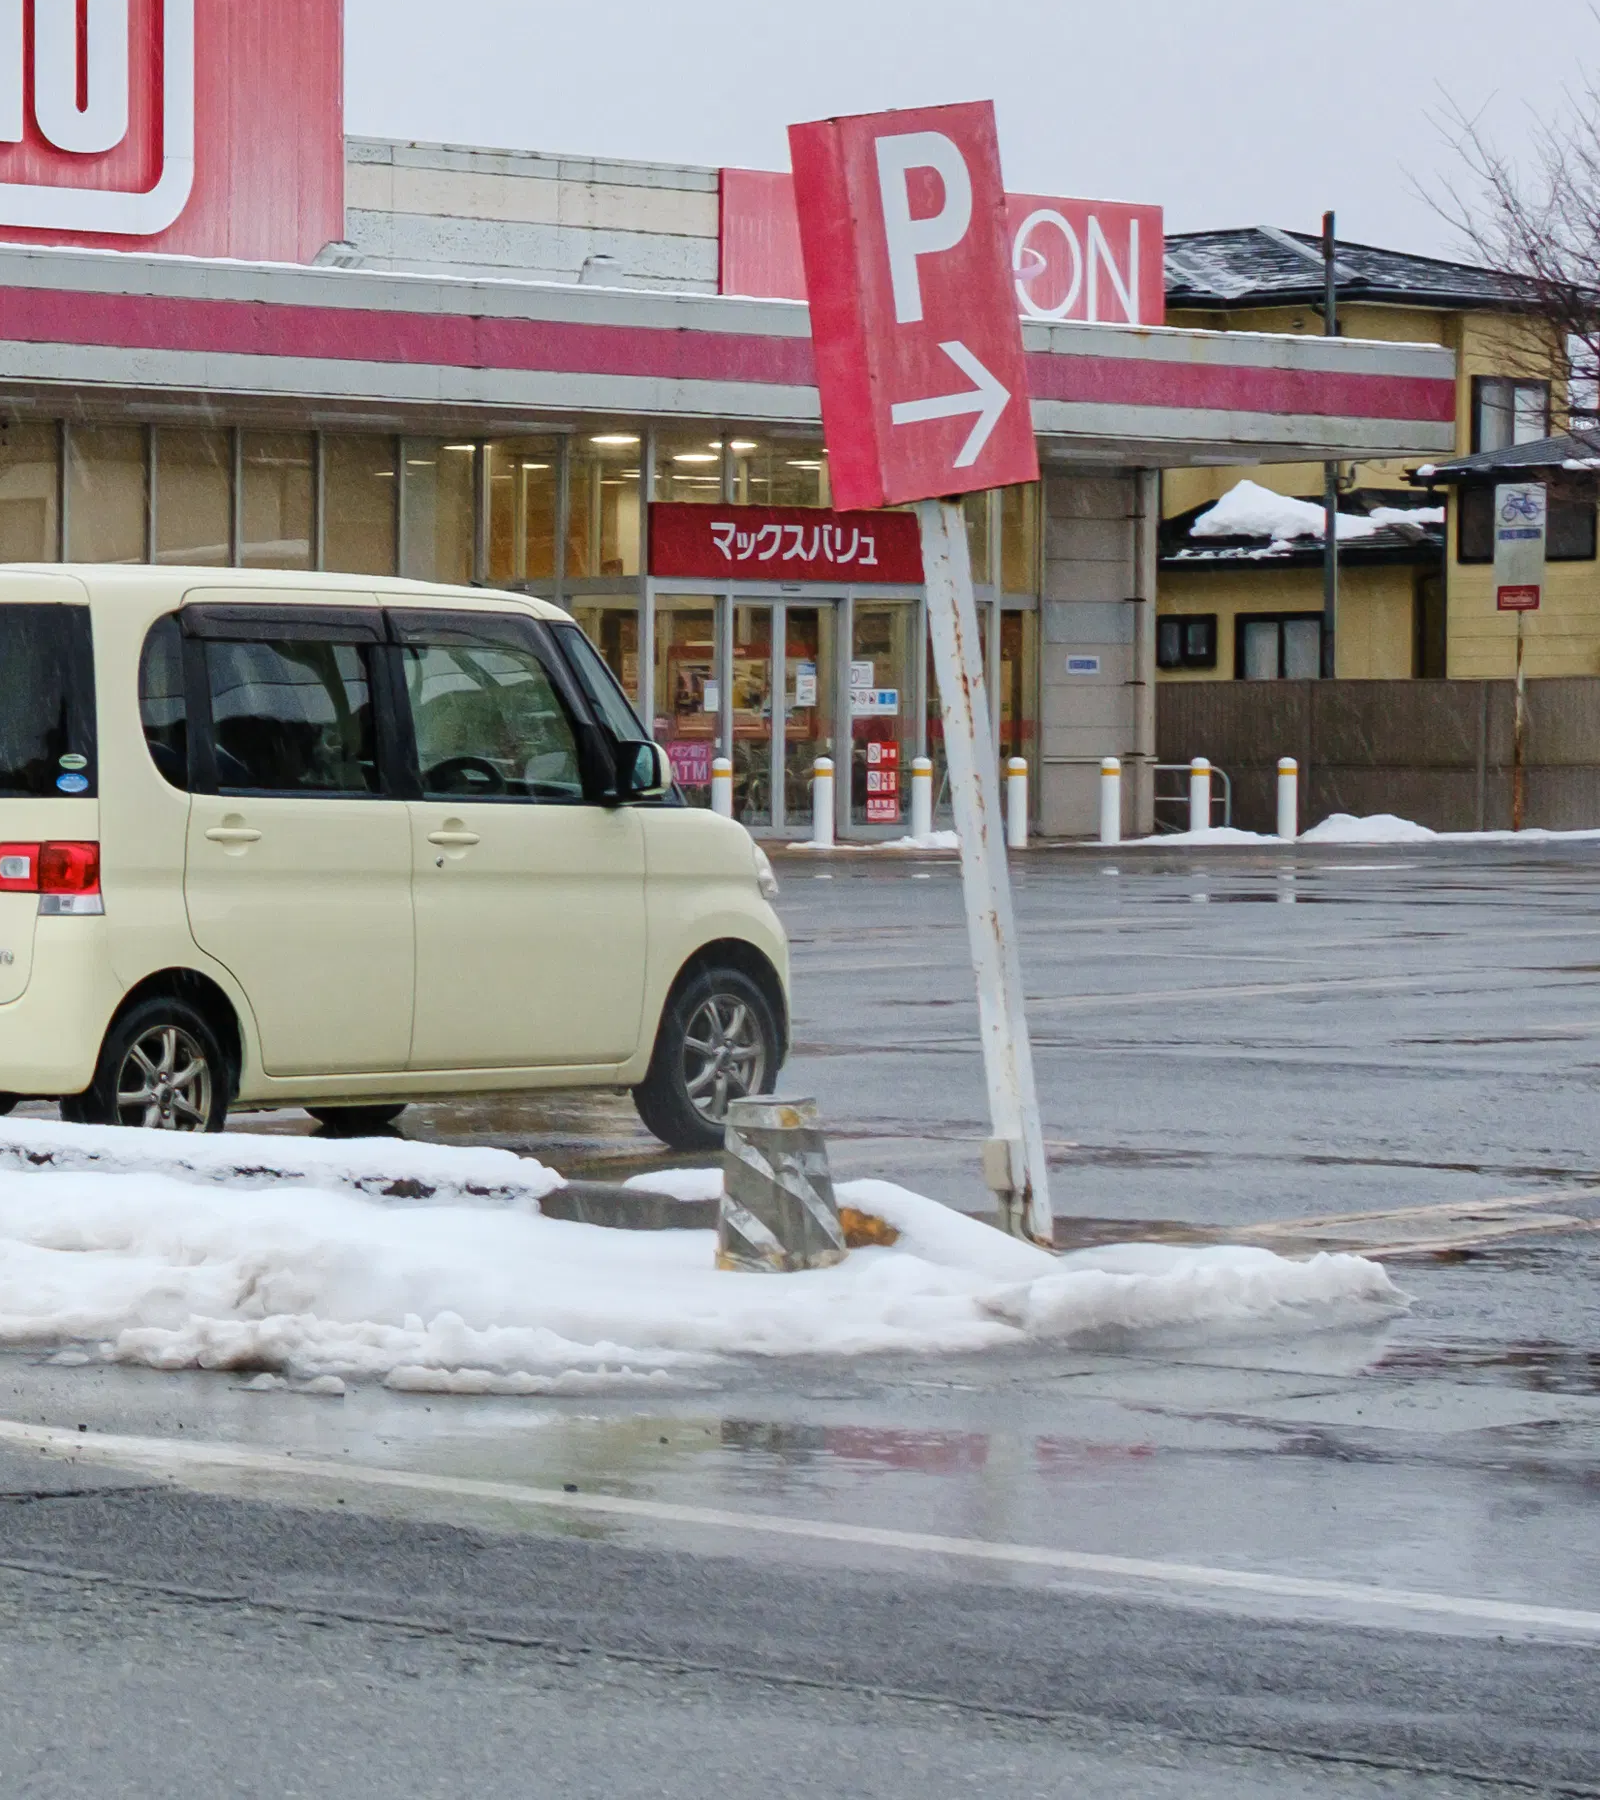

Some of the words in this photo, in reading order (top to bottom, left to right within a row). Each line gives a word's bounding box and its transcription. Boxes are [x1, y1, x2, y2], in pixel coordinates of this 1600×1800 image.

[873, 130, 973, 324] P
[709, 521, 879, 567] マックスバリュ
